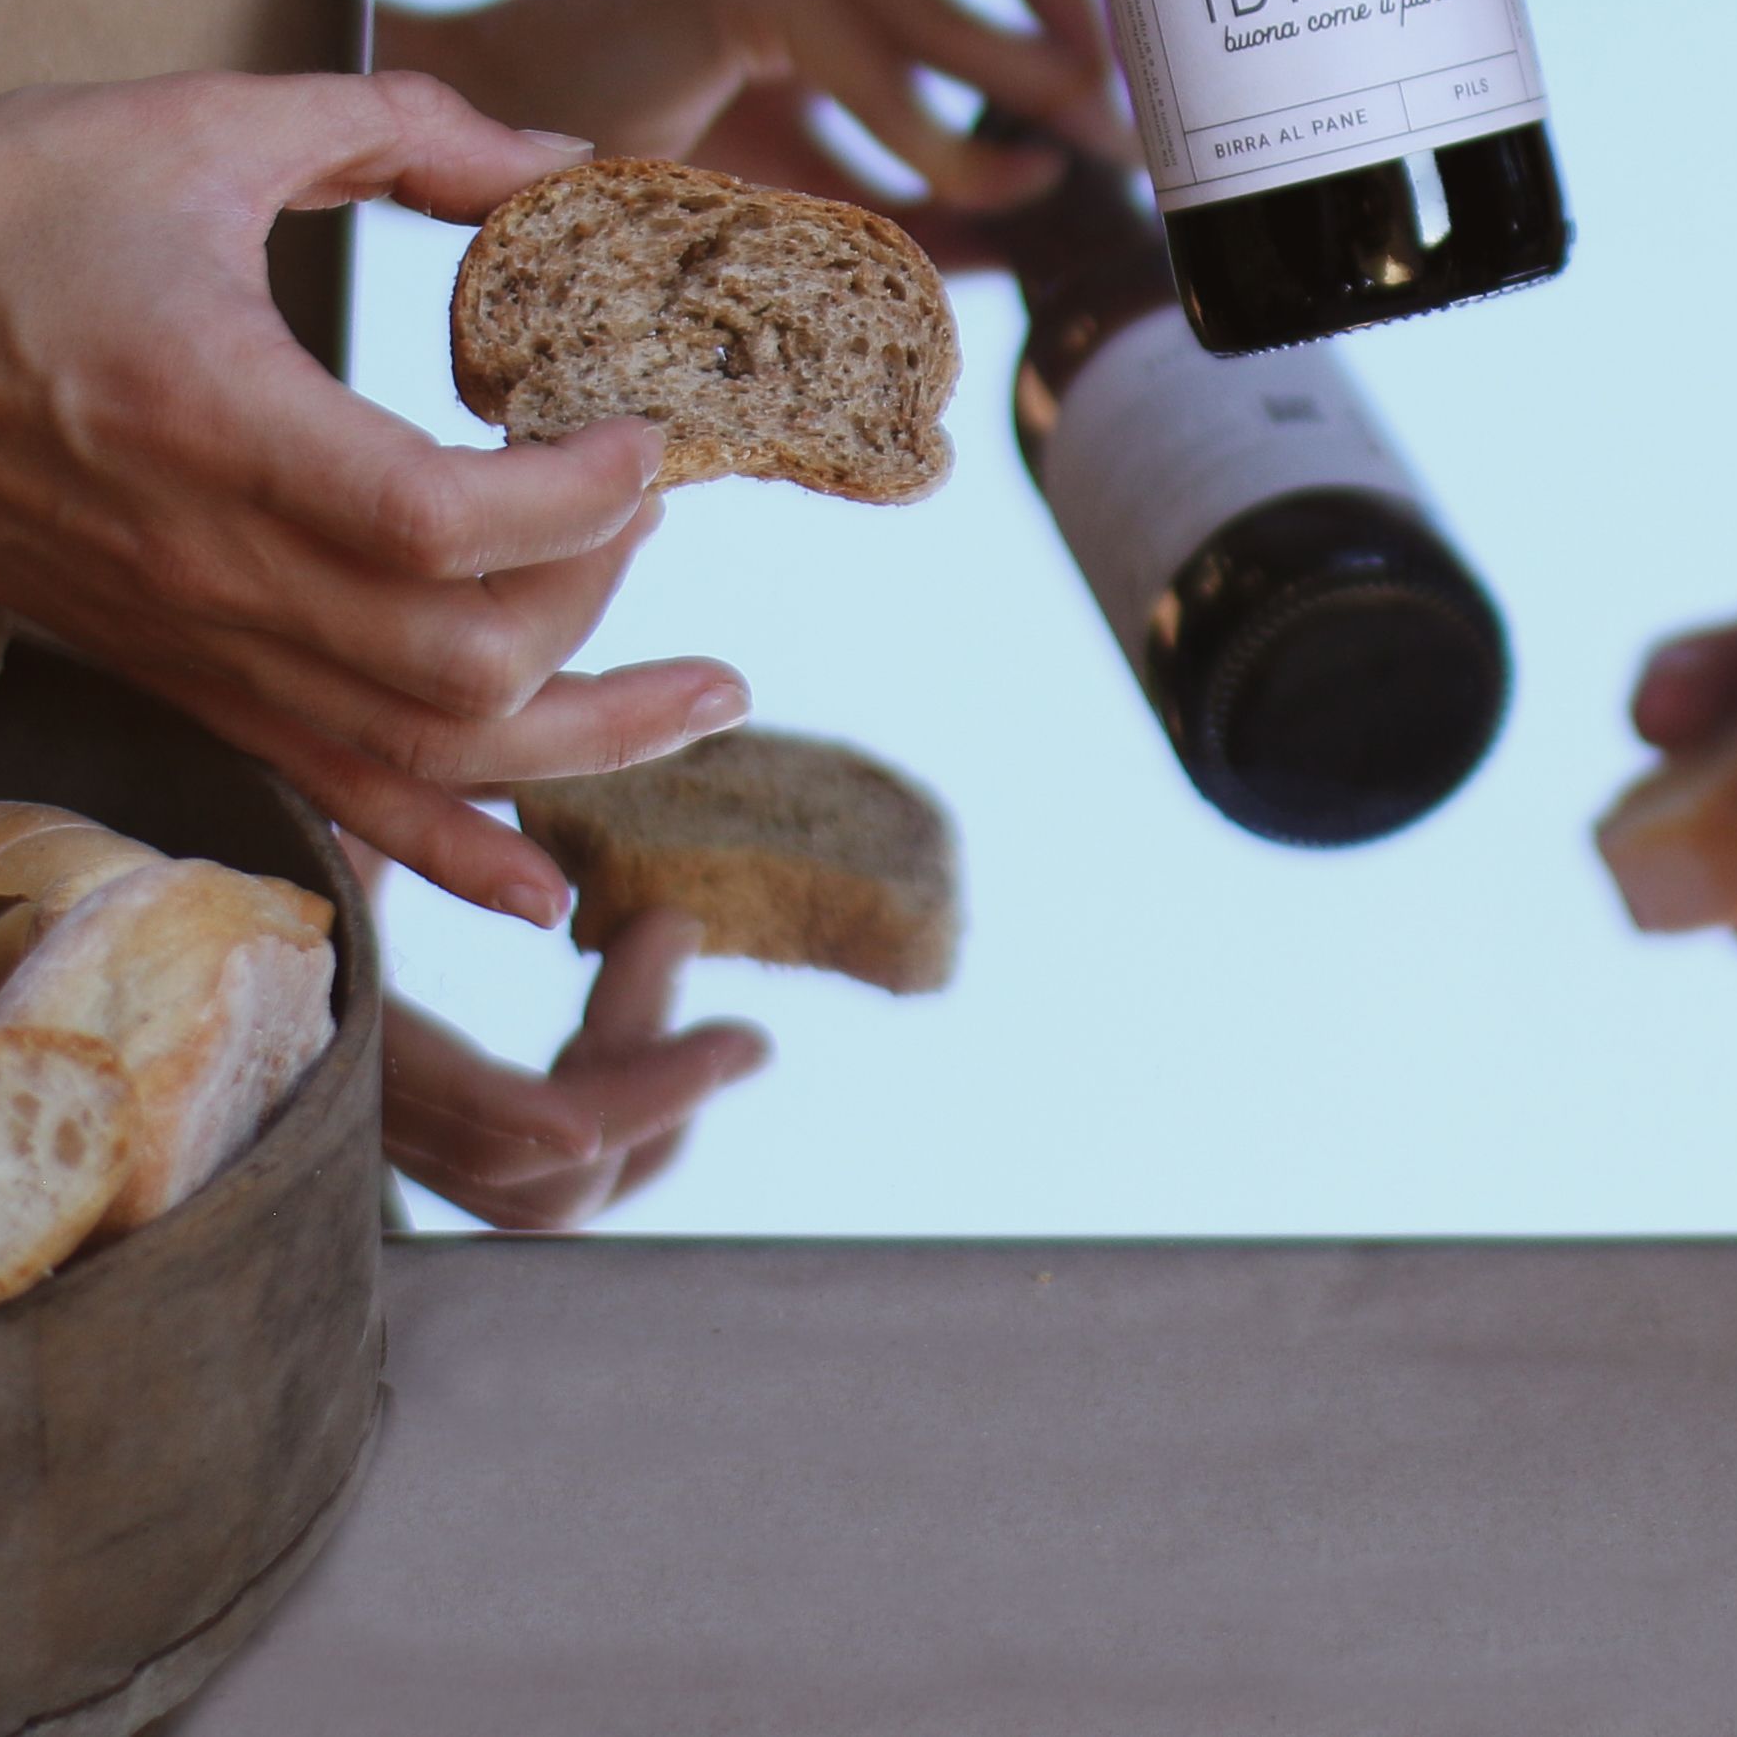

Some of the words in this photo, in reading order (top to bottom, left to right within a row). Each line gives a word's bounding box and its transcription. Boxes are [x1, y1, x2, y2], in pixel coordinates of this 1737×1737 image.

[1224, 21, 1300, 53] buona
[1307, 3, 1372, 32] come
[1453, 78, 1488, 100] PILS
[1215, 133, 1271, 159] BIRRA
[1280, 126, 1304, 144] AL
[1312, 109, 1367, 135] PANE
